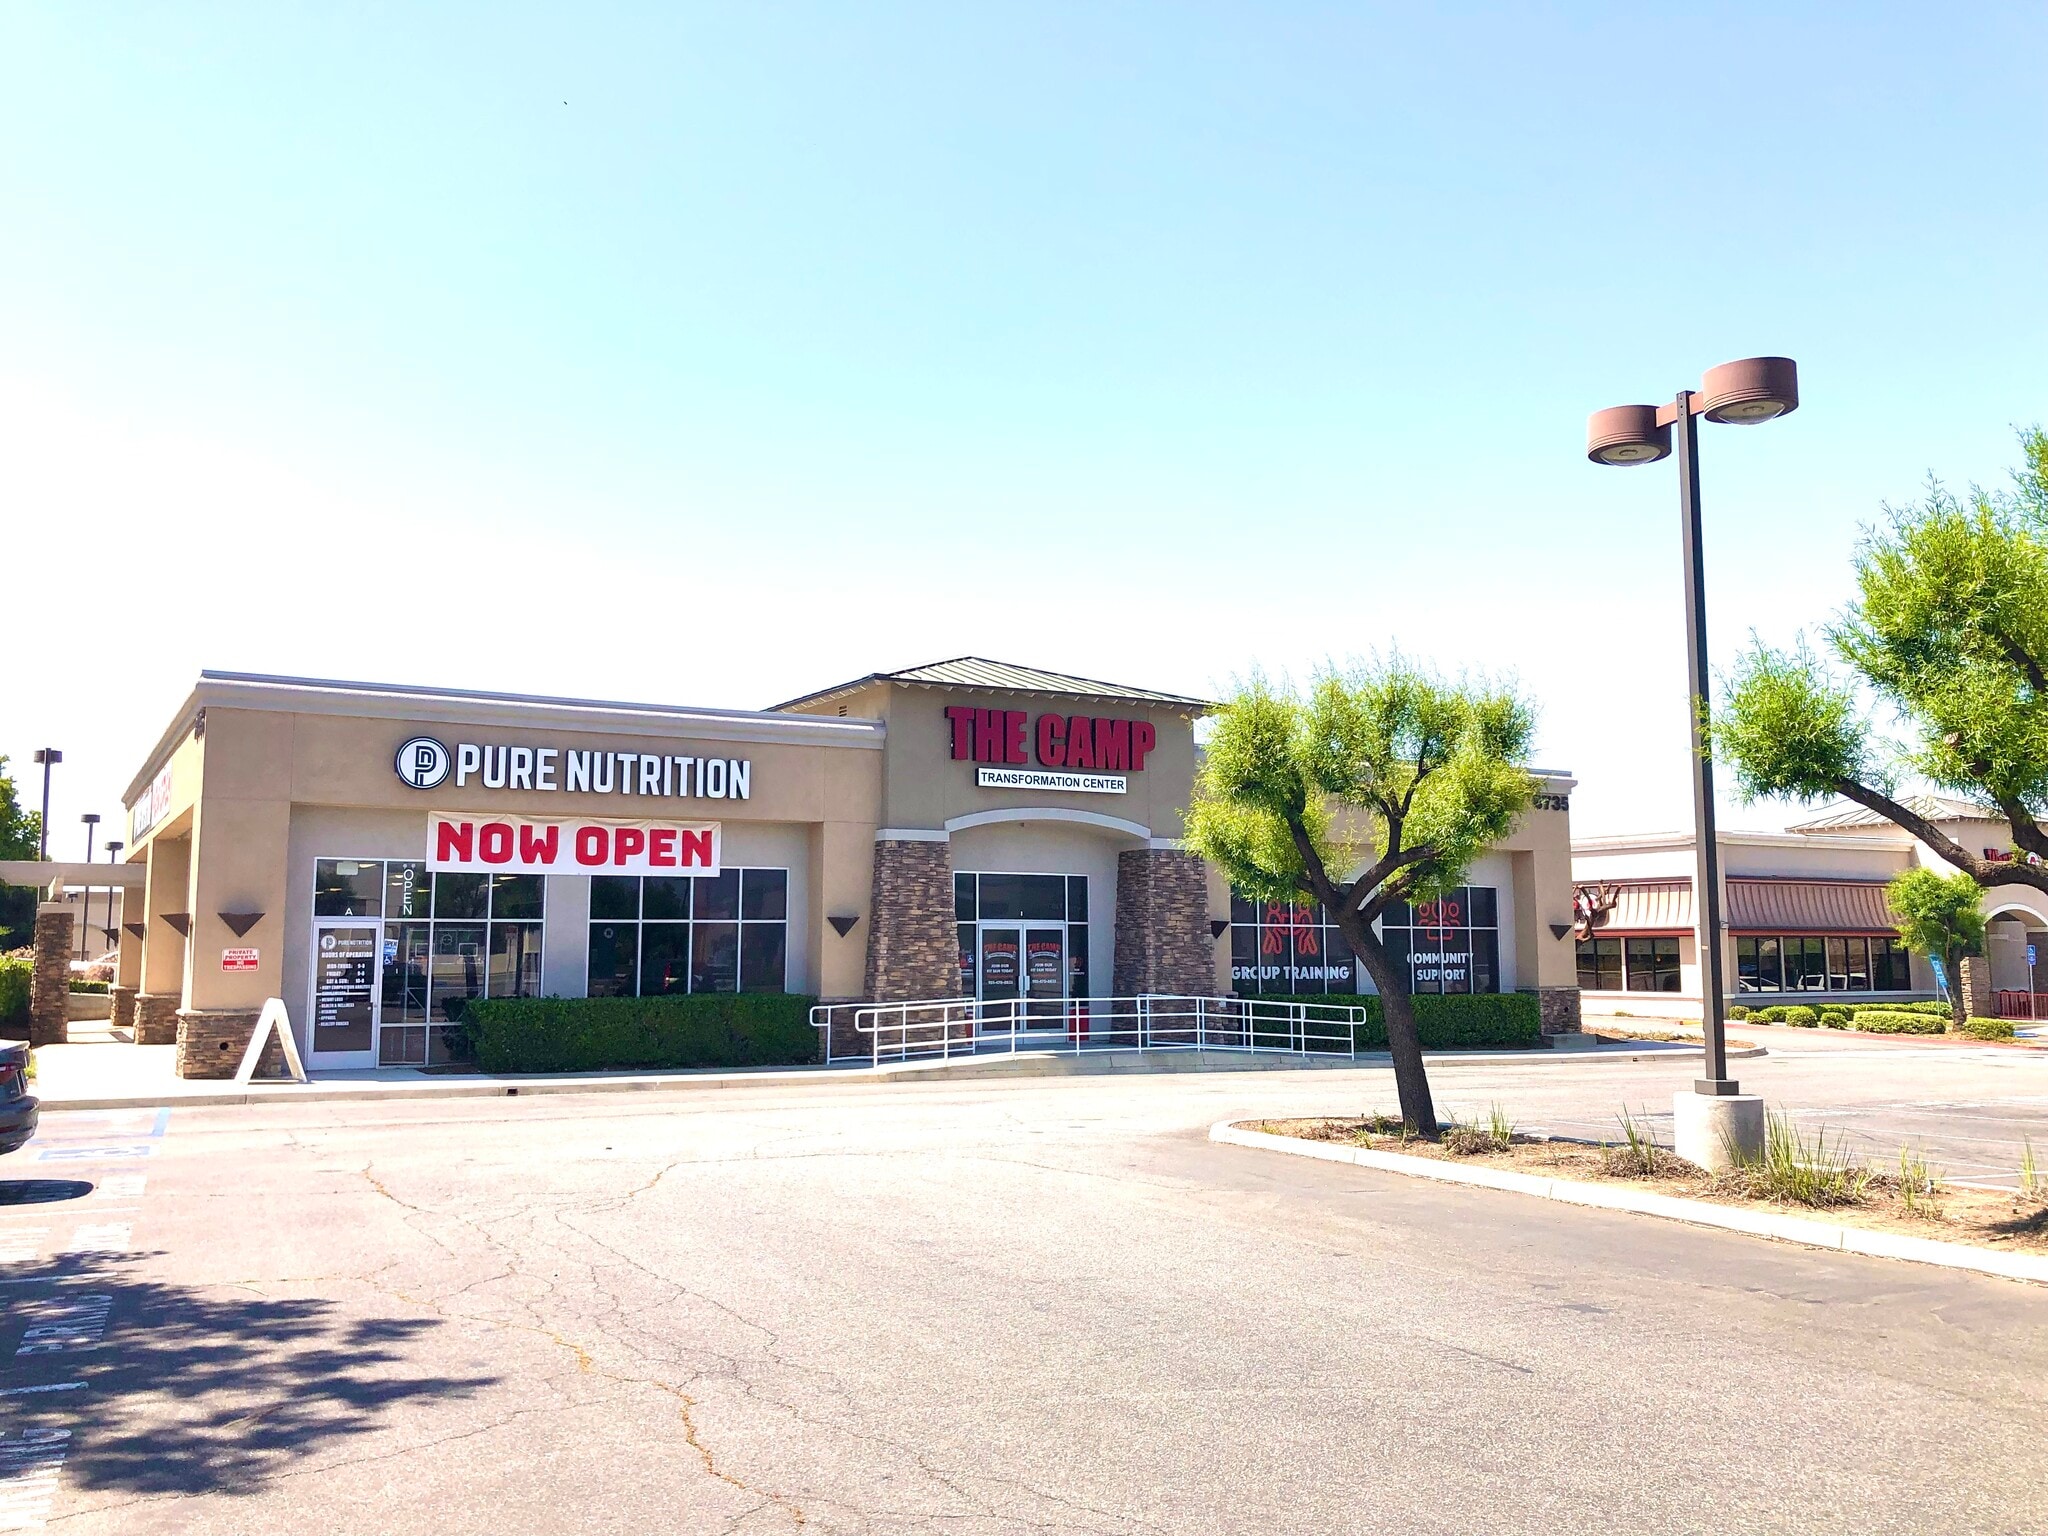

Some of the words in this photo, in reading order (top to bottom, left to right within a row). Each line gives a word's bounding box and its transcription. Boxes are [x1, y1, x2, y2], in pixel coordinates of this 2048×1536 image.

[945, 706, 1028, 764] THE
[1036, 713, 1156, 771] CAMP
[456, 744, 558, 792] PURE
[566, 749, 752, 800] NUTRITION
[981, 772, 1080, 790] TRANSFORMATION
[1083, 777, 1125, 791] CENTER
[437, 822, 559, 865] NOW
[576, 826, 714, 867] OPEN
[345, 907, 353, 916] A
[1232, 966, 1280, 980] GROUP
[1283, 966, 1350, 980] TRAINING
